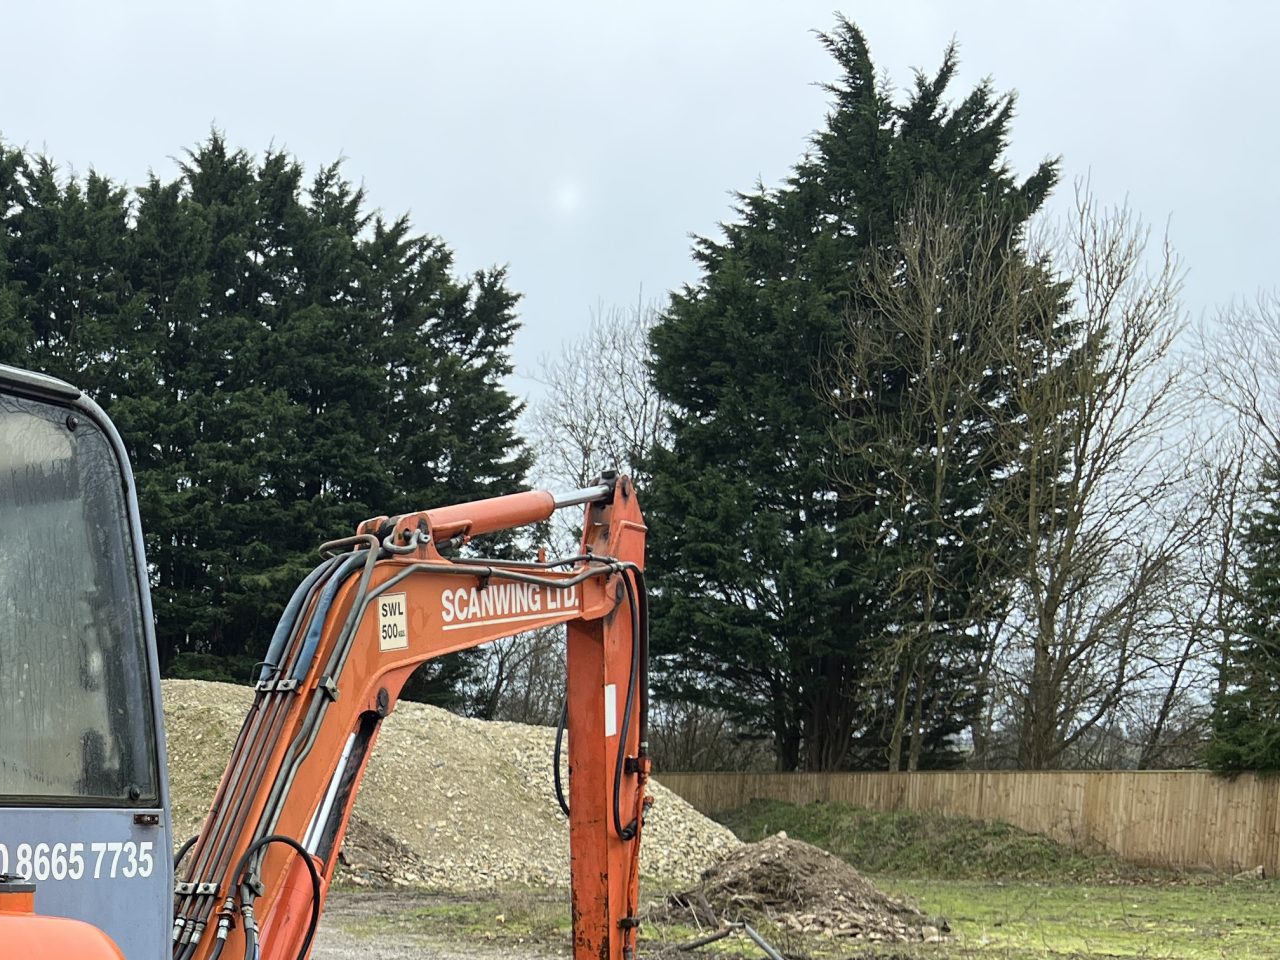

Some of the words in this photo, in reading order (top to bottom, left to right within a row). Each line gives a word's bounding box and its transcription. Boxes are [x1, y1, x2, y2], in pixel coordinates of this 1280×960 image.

[381, 601, 403, 617] SWL
[442, 583, 541, 622] SCANWING
[382, 623, 398, 640] 500
[16, 842, 84, 882] 8665
[91, 841, 154, 879] 7735
